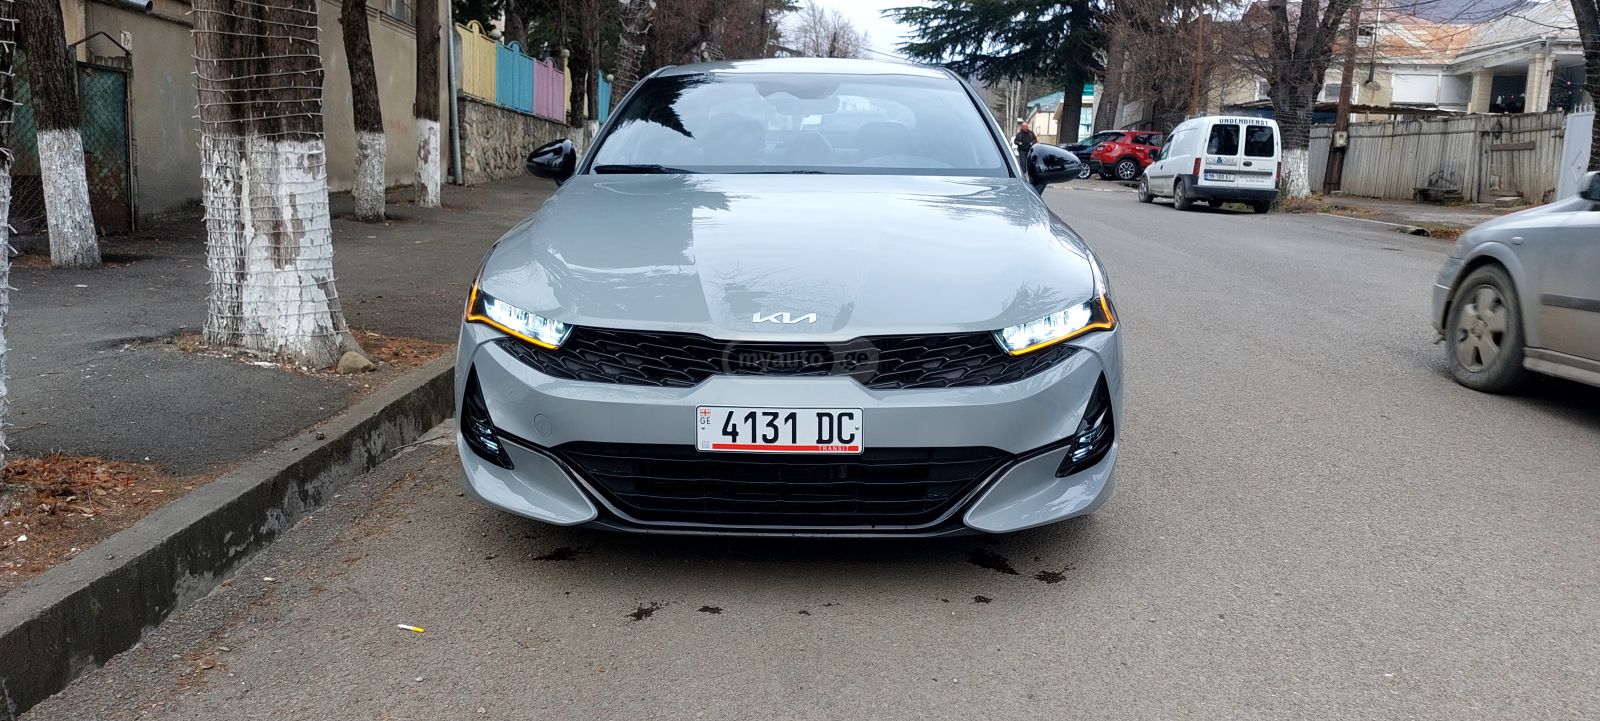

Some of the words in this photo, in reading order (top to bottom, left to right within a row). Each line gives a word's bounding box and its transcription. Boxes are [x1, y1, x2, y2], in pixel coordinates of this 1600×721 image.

[752, 311, 817, 324] KIA
[721, 411, 797, 444] 4131
[816, 411, 856, 444] DC
